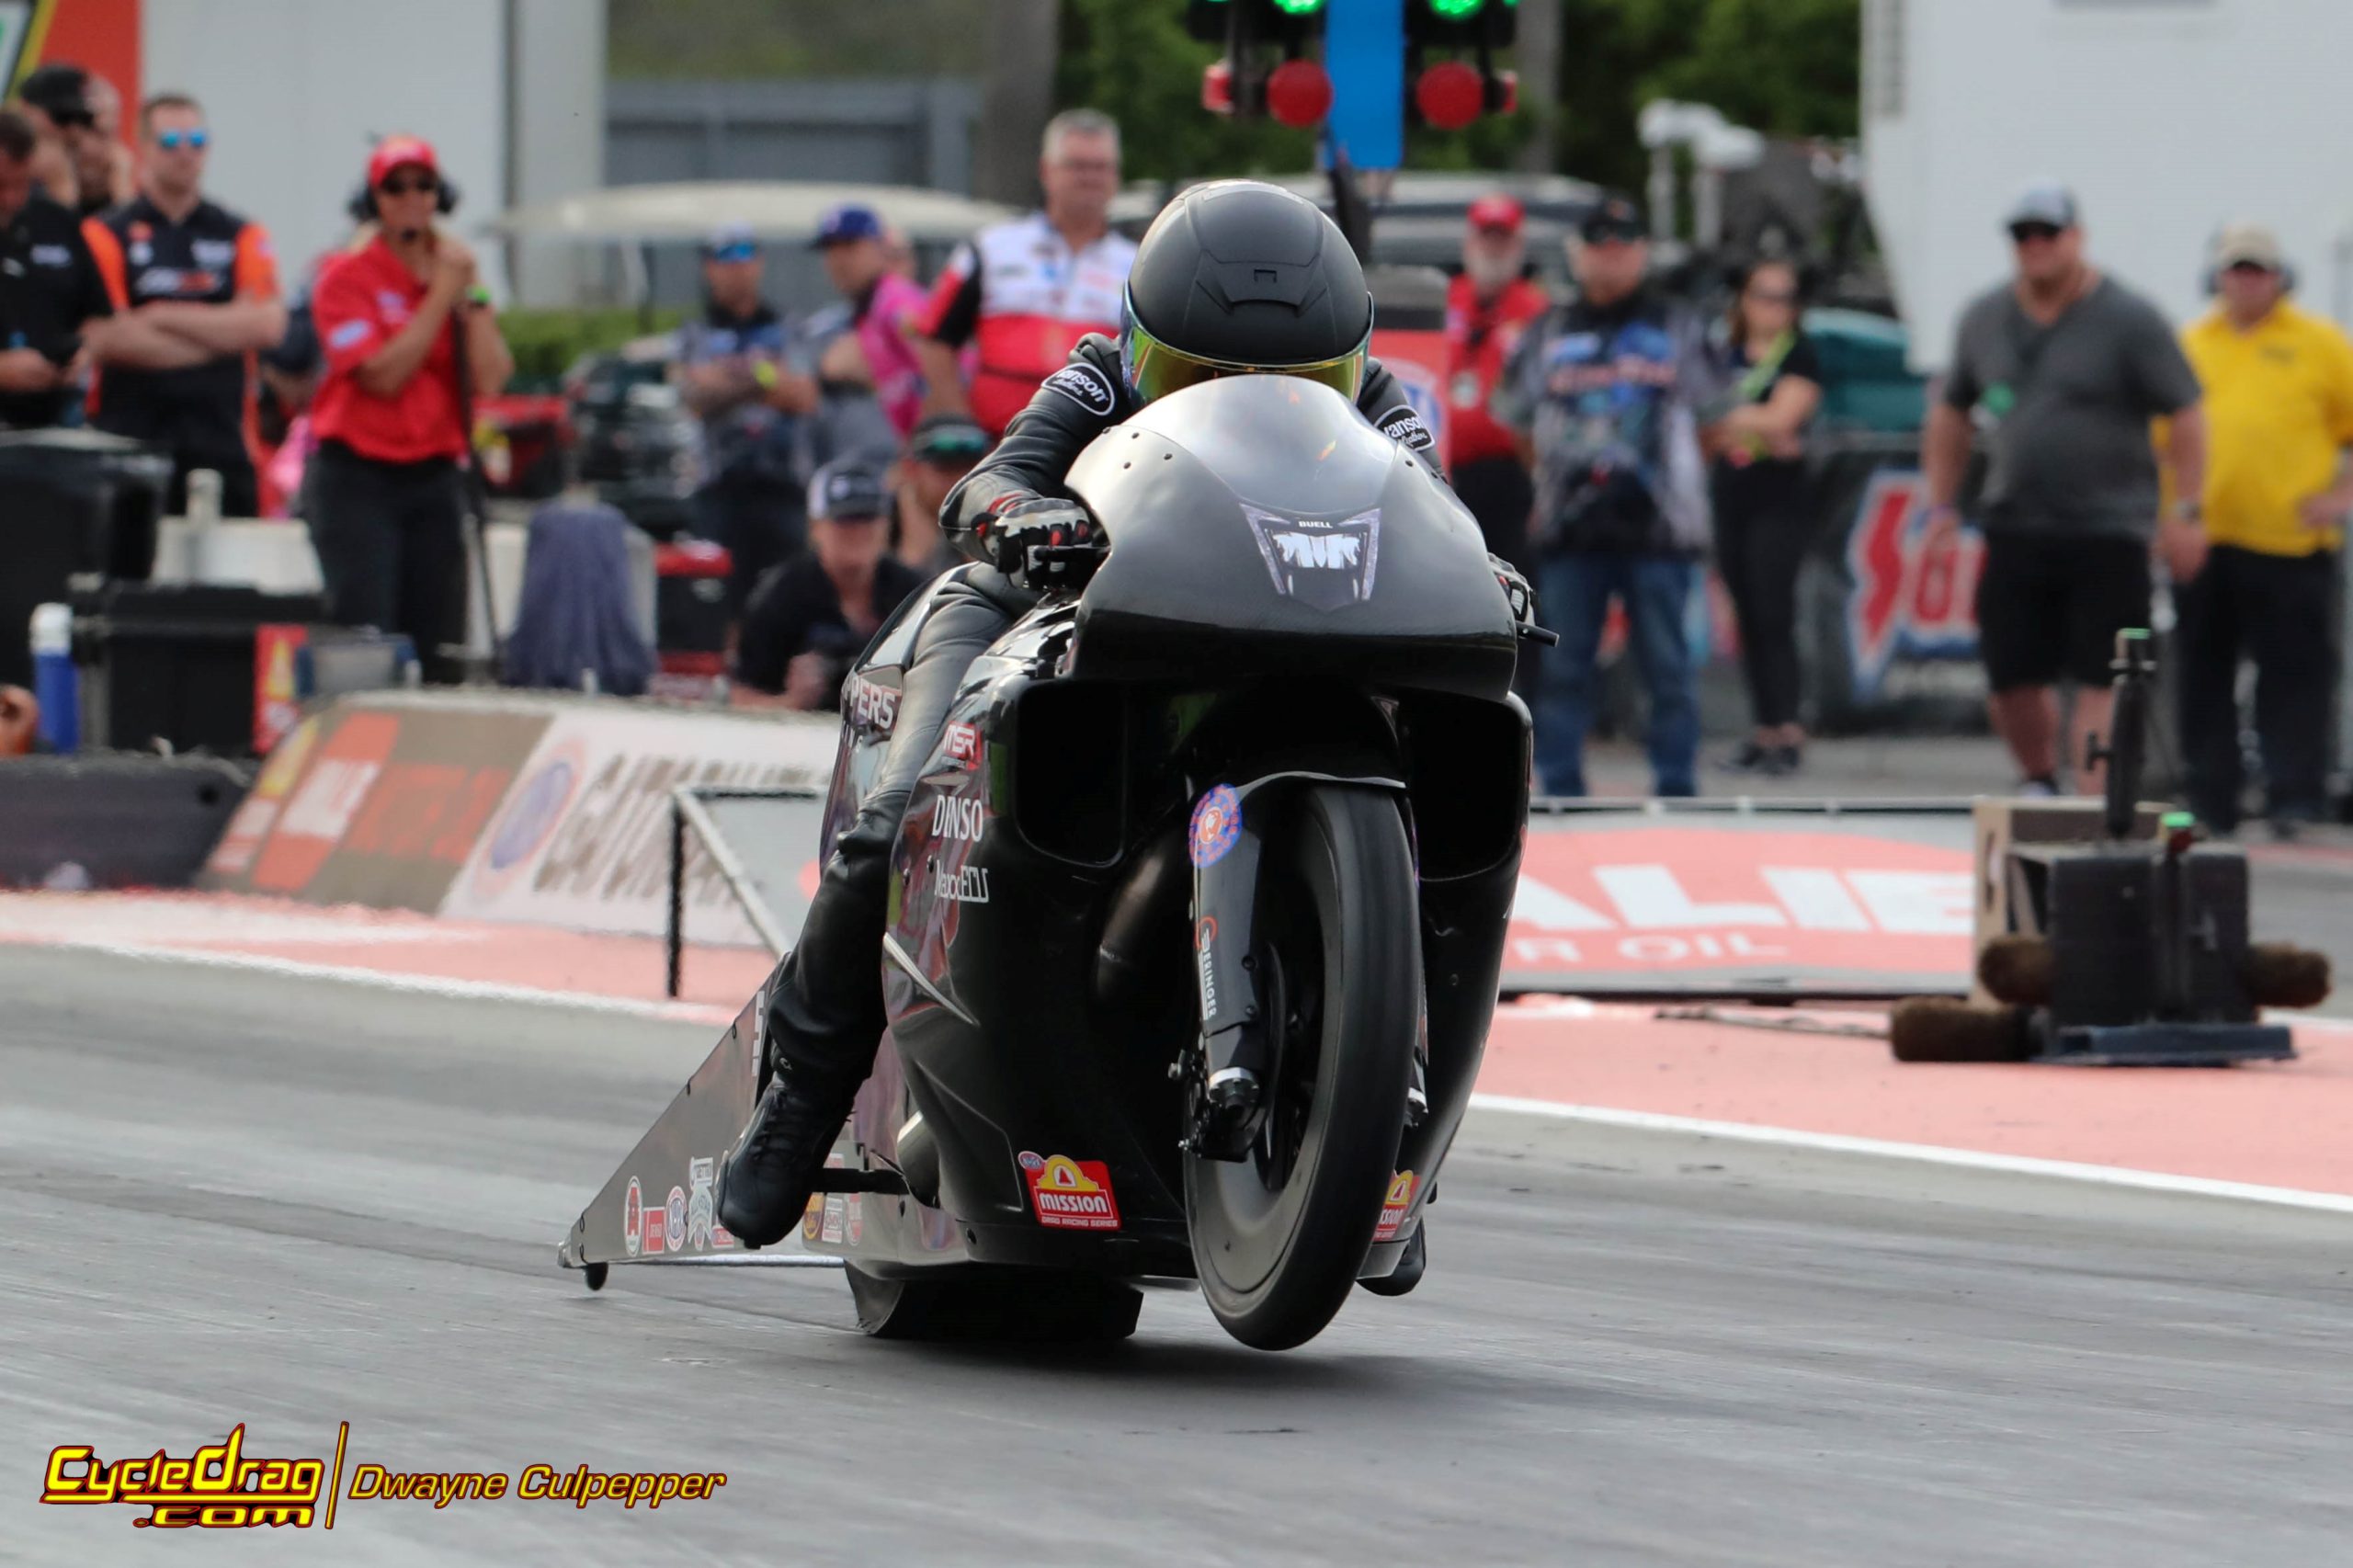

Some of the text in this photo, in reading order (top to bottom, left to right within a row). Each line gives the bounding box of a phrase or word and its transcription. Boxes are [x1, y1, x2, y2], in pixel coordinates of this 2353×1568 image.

[1298, 520, 1334, 529] BUELL
[1616, 932, 1789, 960] OIL
[1039, 1193, 1108, 1213] MISSION
